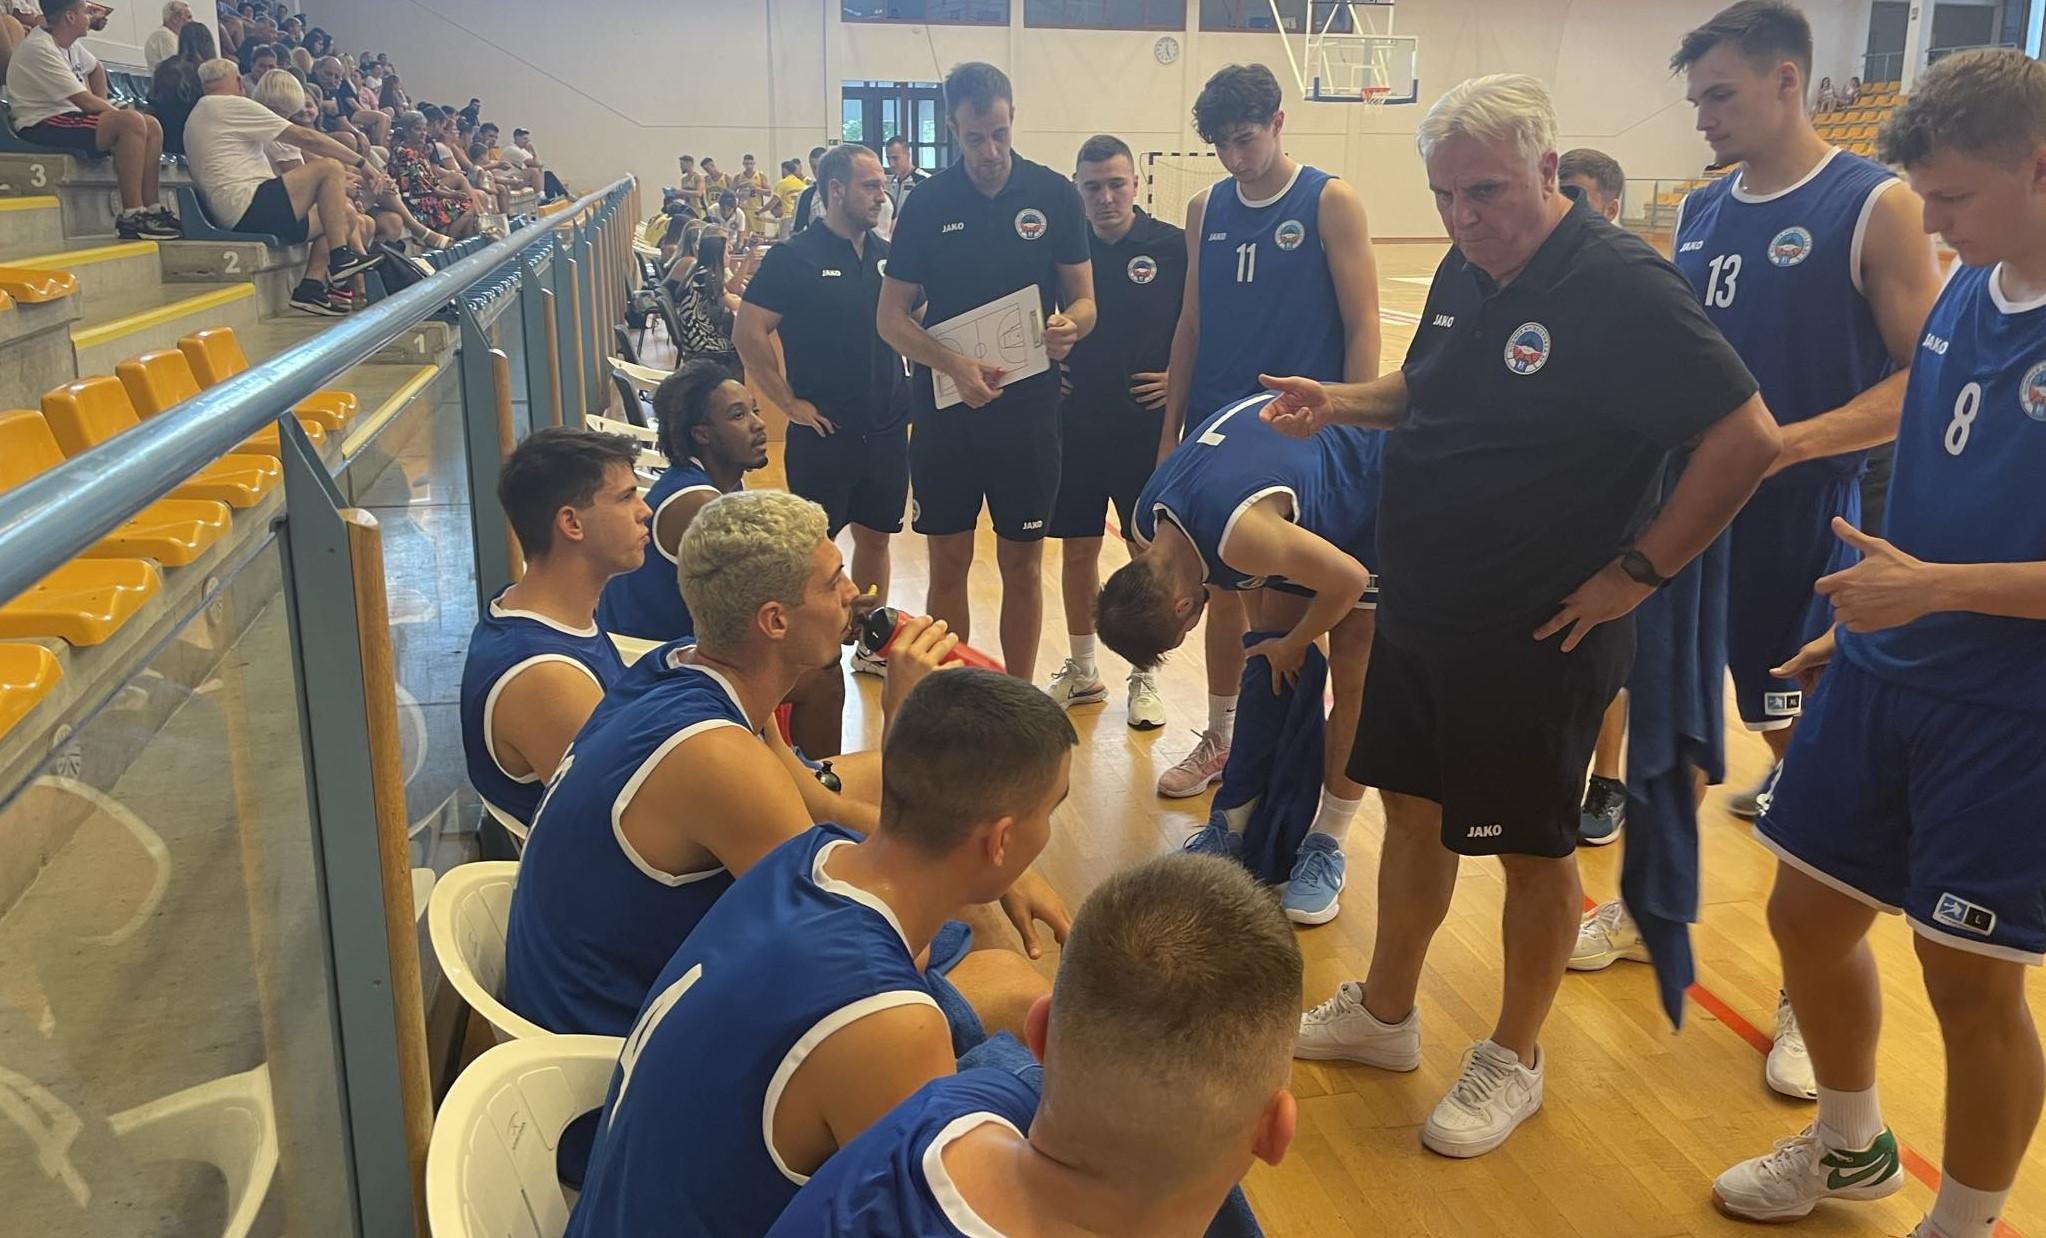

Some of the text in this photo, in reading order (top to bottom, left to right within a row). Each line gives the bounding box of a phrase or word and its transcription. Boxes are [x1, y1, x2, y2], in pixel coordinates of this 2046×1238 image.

[30, 164, 47, 187] 3
[942, 222, 965, 233] JAKO
[1680, 240, 1704, 253] JAKO
[224, 251, 241, 274] 2
[1236, 243, 1257, 282] 11
[1705, 254, 1742, 308] 13
[1433, 313, 1455, 328] JAKO
[413, 333, 425, 354] 1
[1922, 332, 1949, 355] JAKO
[1945, 381, 1982, 456] 8
[1467, 824, 1503, 838] JAKO
